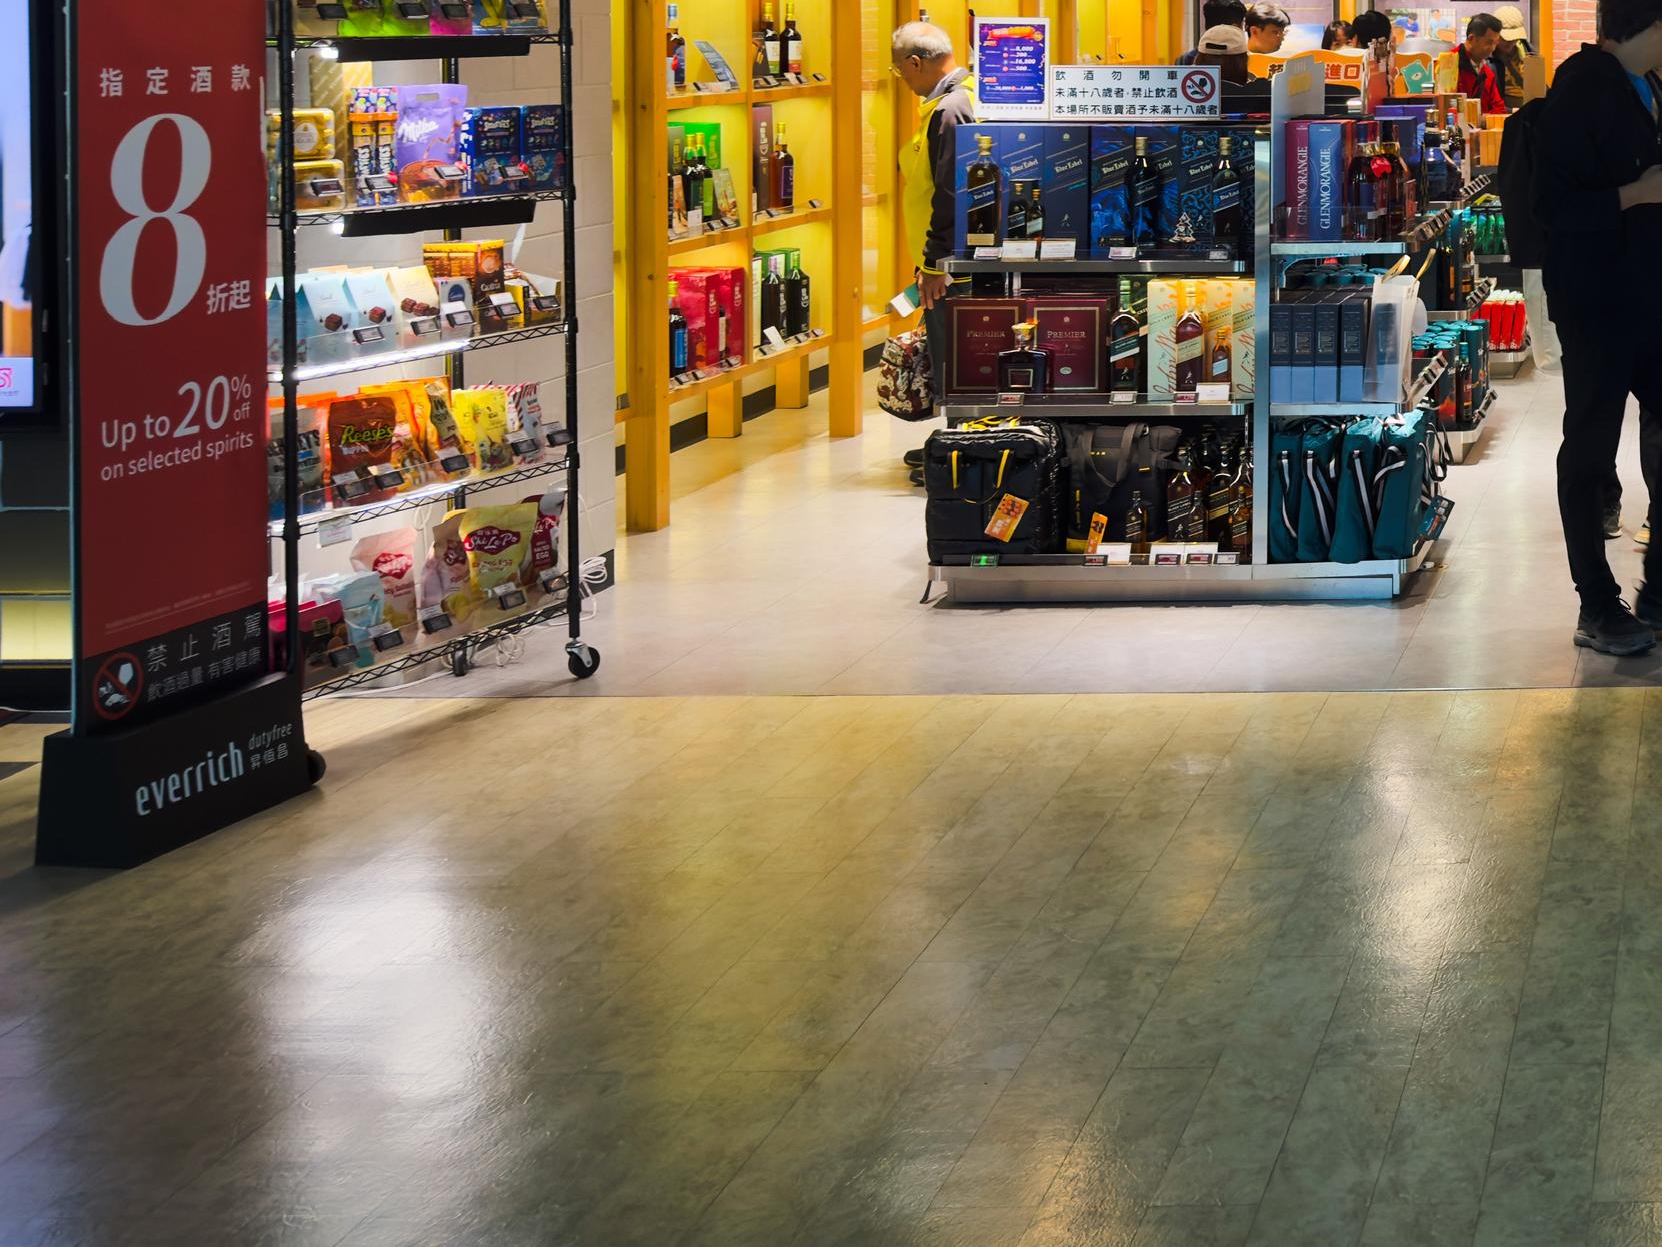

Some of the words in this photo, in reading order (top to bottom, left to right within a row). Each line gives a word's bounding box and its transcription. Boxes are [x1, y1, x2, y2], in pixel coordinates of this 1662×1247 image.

[100, 64, 252, 98] 指定酒款
[1055, 70, 1179, 81] 飲酒勿開車
[1325, 63, 1361, 81] 進口
[1055, 104, 1218, 116] 本場所不販賣酒予未滿十八歲者
[1297, 146, 1309, 225] GLENMORANGIE
[1319, 147, 1331, 230] GLENMORANGIE
[99, 113, 212, 326] 8
[206, 279, 252, 316] 折起
[1047, 330, 1086, 338] PREMIER
[102, 419, 137, 451] Up
[144, 414, 170, 439] to
[173, 374, 251, 438] 20%
[233, 402, 250, 421] off
[101, 463, 124, 481] on
[128, 441, 202, 475] selected
[206, 431, 254, 460] spirits
[135, 741, 245, 817] everrich
[249, 722, 293, 750] dutyfree
